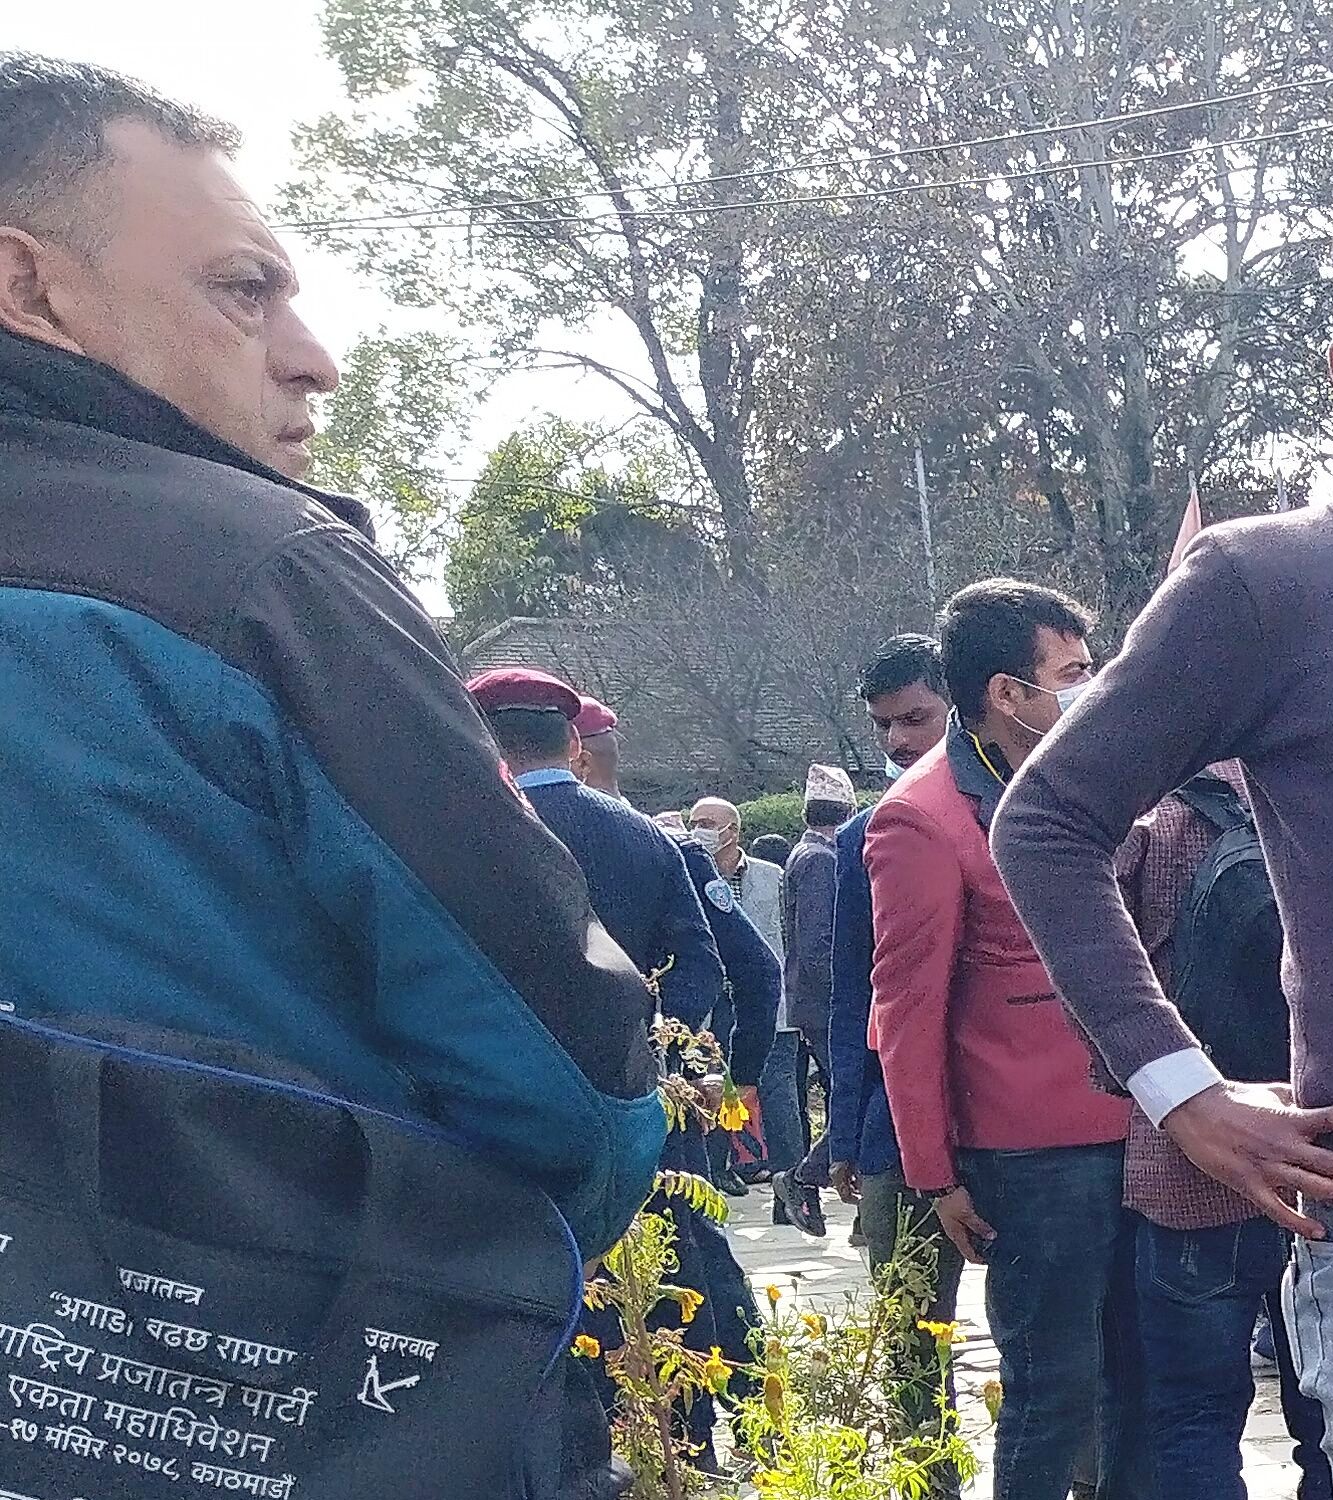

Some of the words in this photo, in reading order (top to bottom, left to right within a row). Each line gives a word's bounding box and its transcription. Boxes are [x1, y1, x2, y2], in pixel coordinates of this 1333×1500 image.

[363, 1327, 441, 1363] उदारवाद
[8, 1374, 97, 1422] एकता
[103, 1399, 277, 1463] महाधिवेशन
[98, 1352, 234, 1409] प्रजातन्त्र
[240, 1387, 319, 1427] पार्टी
[45, 1423, 109, 1460] मंसिर
[191, 1460, 298, 1500] काठमाडौं
